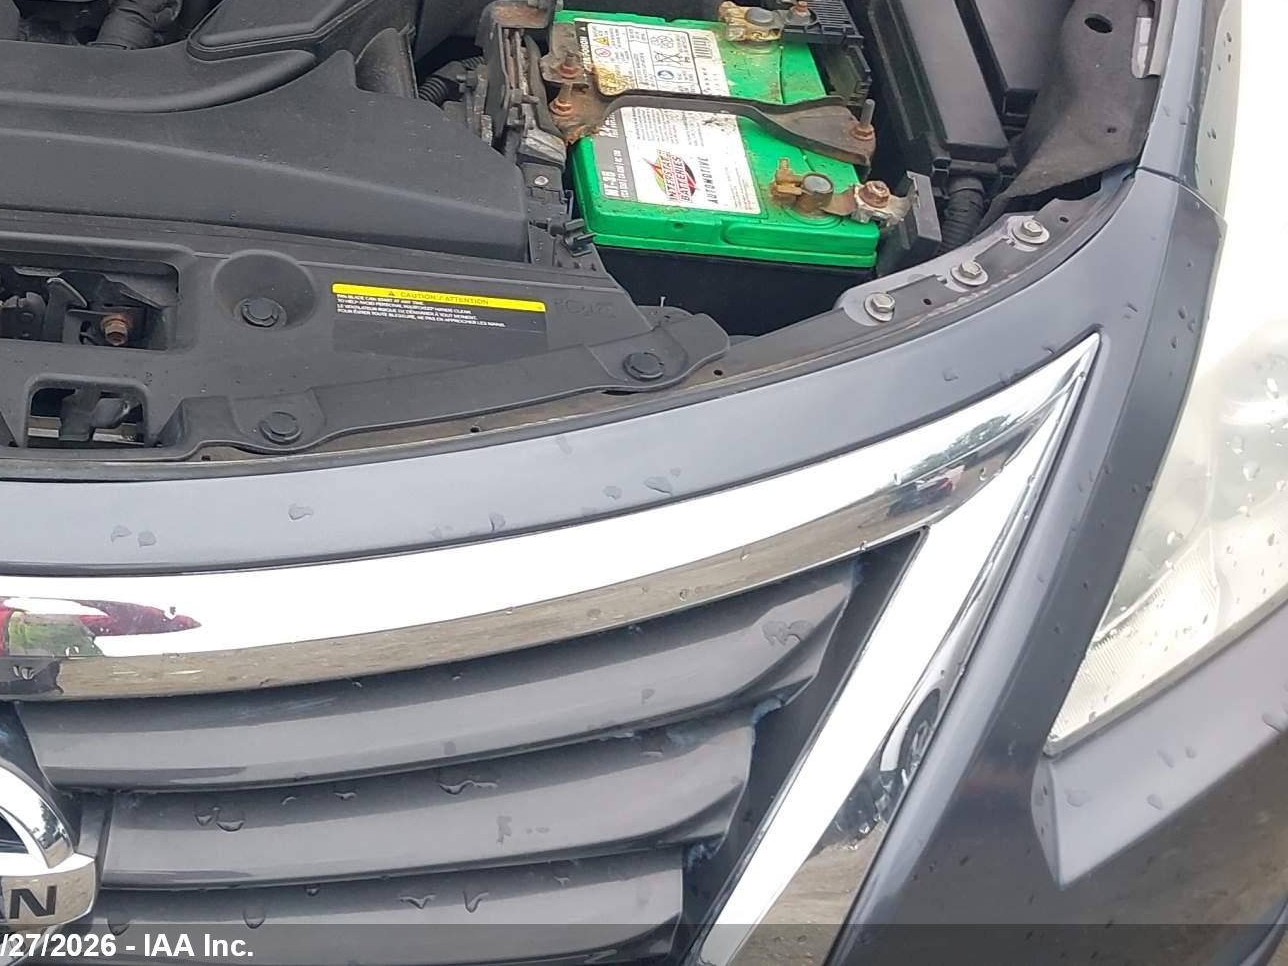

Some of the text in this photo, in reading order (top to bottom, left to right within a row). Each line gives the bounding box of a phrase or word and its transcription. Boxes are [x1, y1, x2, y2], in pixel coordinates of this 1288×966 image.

[674, 156, 691, 202] BATTERIES
[698, 156, 719, 204] AUTOMOTIVE
[400, 292, 438, 300] CAUTION
[445, 296, 489, 305] ATTENTION
